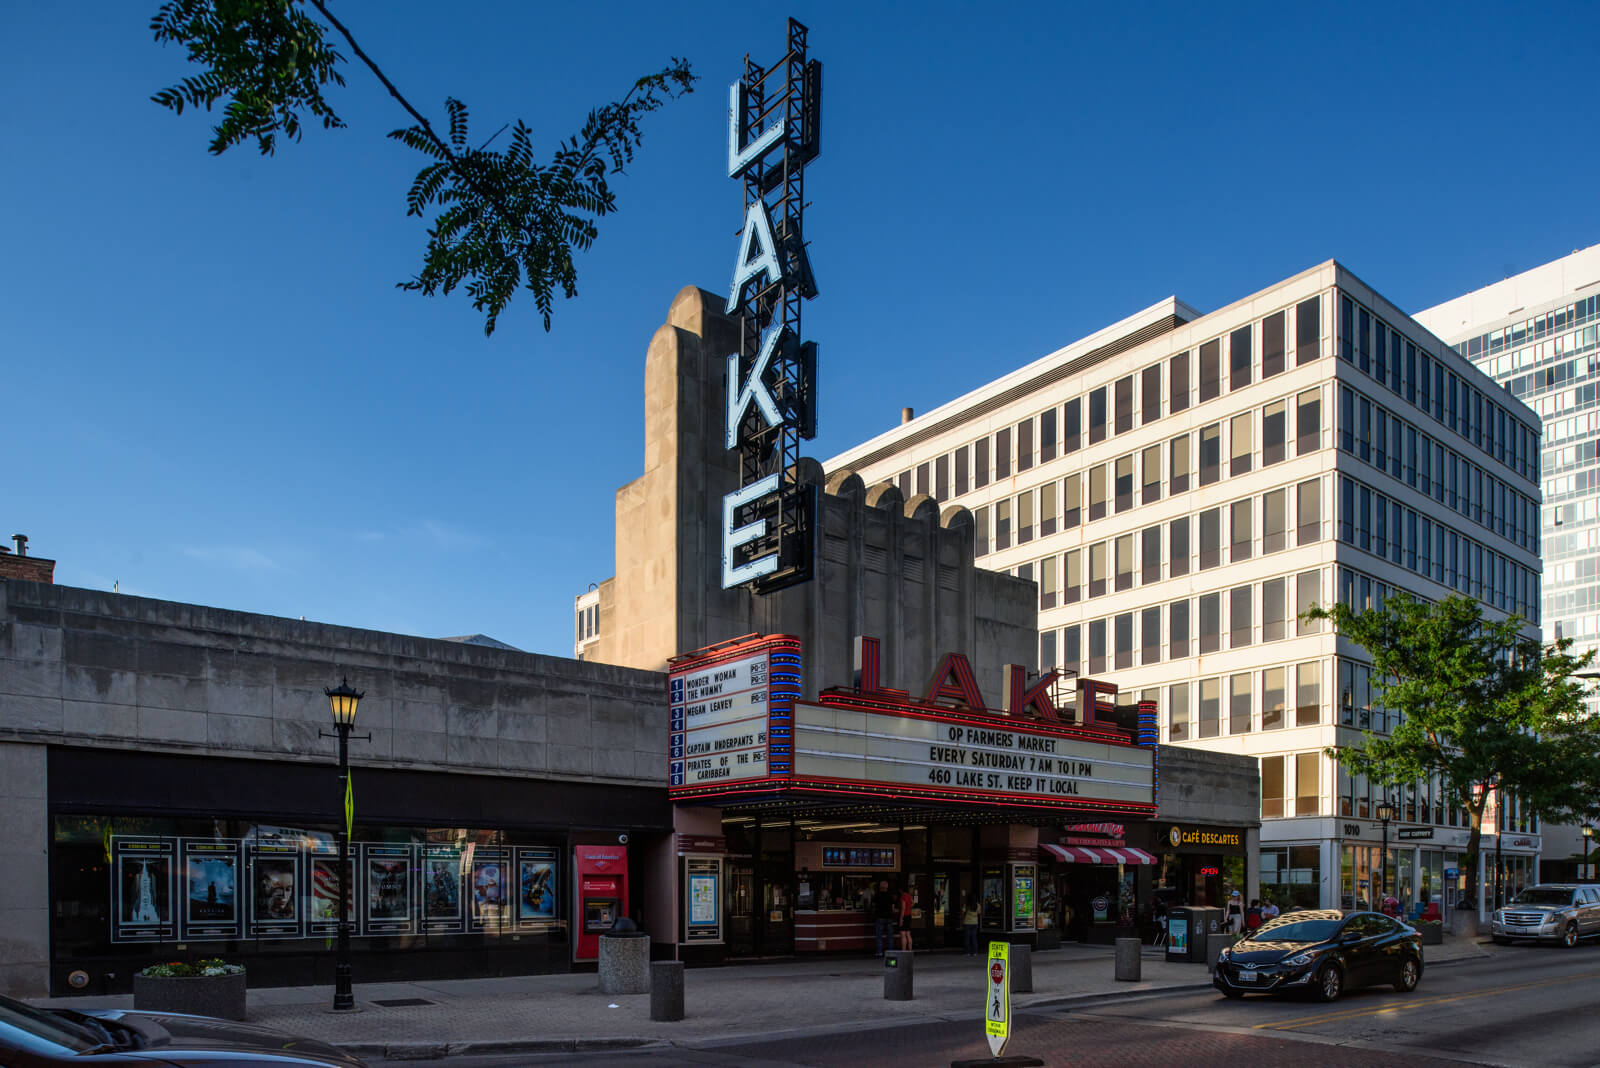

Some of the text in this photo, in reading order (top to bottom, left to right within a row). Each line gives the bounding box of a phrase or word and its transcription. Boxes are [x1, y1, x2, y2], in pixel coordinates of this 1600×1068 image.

[721, 79, 786, 590] LAKE
[675, 680, 679, 690] 1
[687, 669, 736, 689] WONDER WOMAN
[856, 636, 1118, 731] LAKE
[674, 693, 680, 702] 2
[687, 683, 723, 701] THE MUMMY
[674, 709, 680, 718] 3
[687, 698, 733, 717] MEGAN LEAVEY
[674, 722, 680, 730] 4
[674, 736, 680, 745] 5
[687, 742, 711, 755] CAPTAIN
[714, 735, 754, 749] UNDERPANTS
[949, 727, 1056, 753] OP FARMERS MARKET
[674, 748, 680, 757] 6
[674, 763, 680, 773] 7
[687, 759, 712, 771] PIRATES
[720, 756, 728, 766] OF
[737, 753, 749, 764] THE
[930, 746, 966, 764] EVERY
[971, 751, 1025, 770] SATURDAY
[1030, 758, 1036, 771] 7
[1038, 759, 1052, 772] AM
[1058, 760, 1069, 774] TO
[1079, 763, 1092, 777] PM
[674, 775, 680, 785] 8
[697, 767, 731, 780] CARIBBEAN
[928, 769, 1078, 794] 460 LAKE ST. KEEP IT LOCAL
[1182, 829, 1239, 845] CAFÉ DESCARTES
[1344, 824, 1360, 836] 1010
[1200, 867, 1219, 875] OPEN
